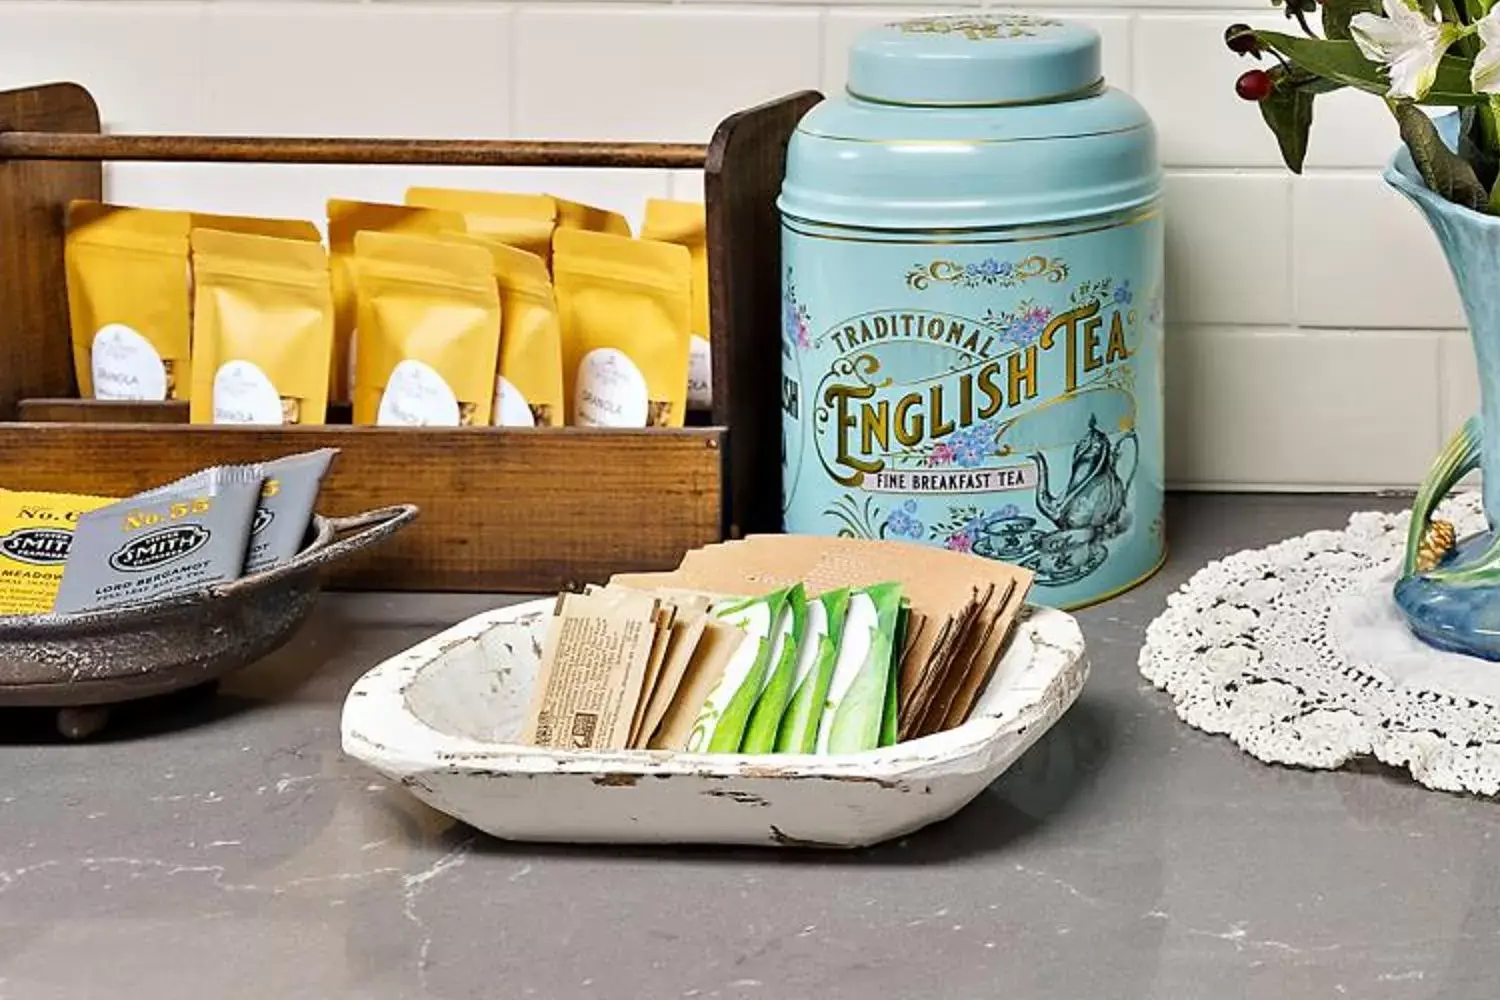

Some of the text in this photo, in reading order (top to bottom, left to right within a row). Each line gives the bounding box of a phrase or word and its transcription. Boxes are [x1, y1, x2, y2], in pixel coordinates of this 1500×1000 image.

[831, 314, 998, 358] TRADITIONAL
[825, 298, 1130, 482] ENGLISH TEA
[877, 468, 1025, 490] FINE BREAKFAST TEA
[123, 535, 196, 563] SMITH
[95, 581, 133, 595] LORD
[136, 560, 211, 586] BERGAMOT
